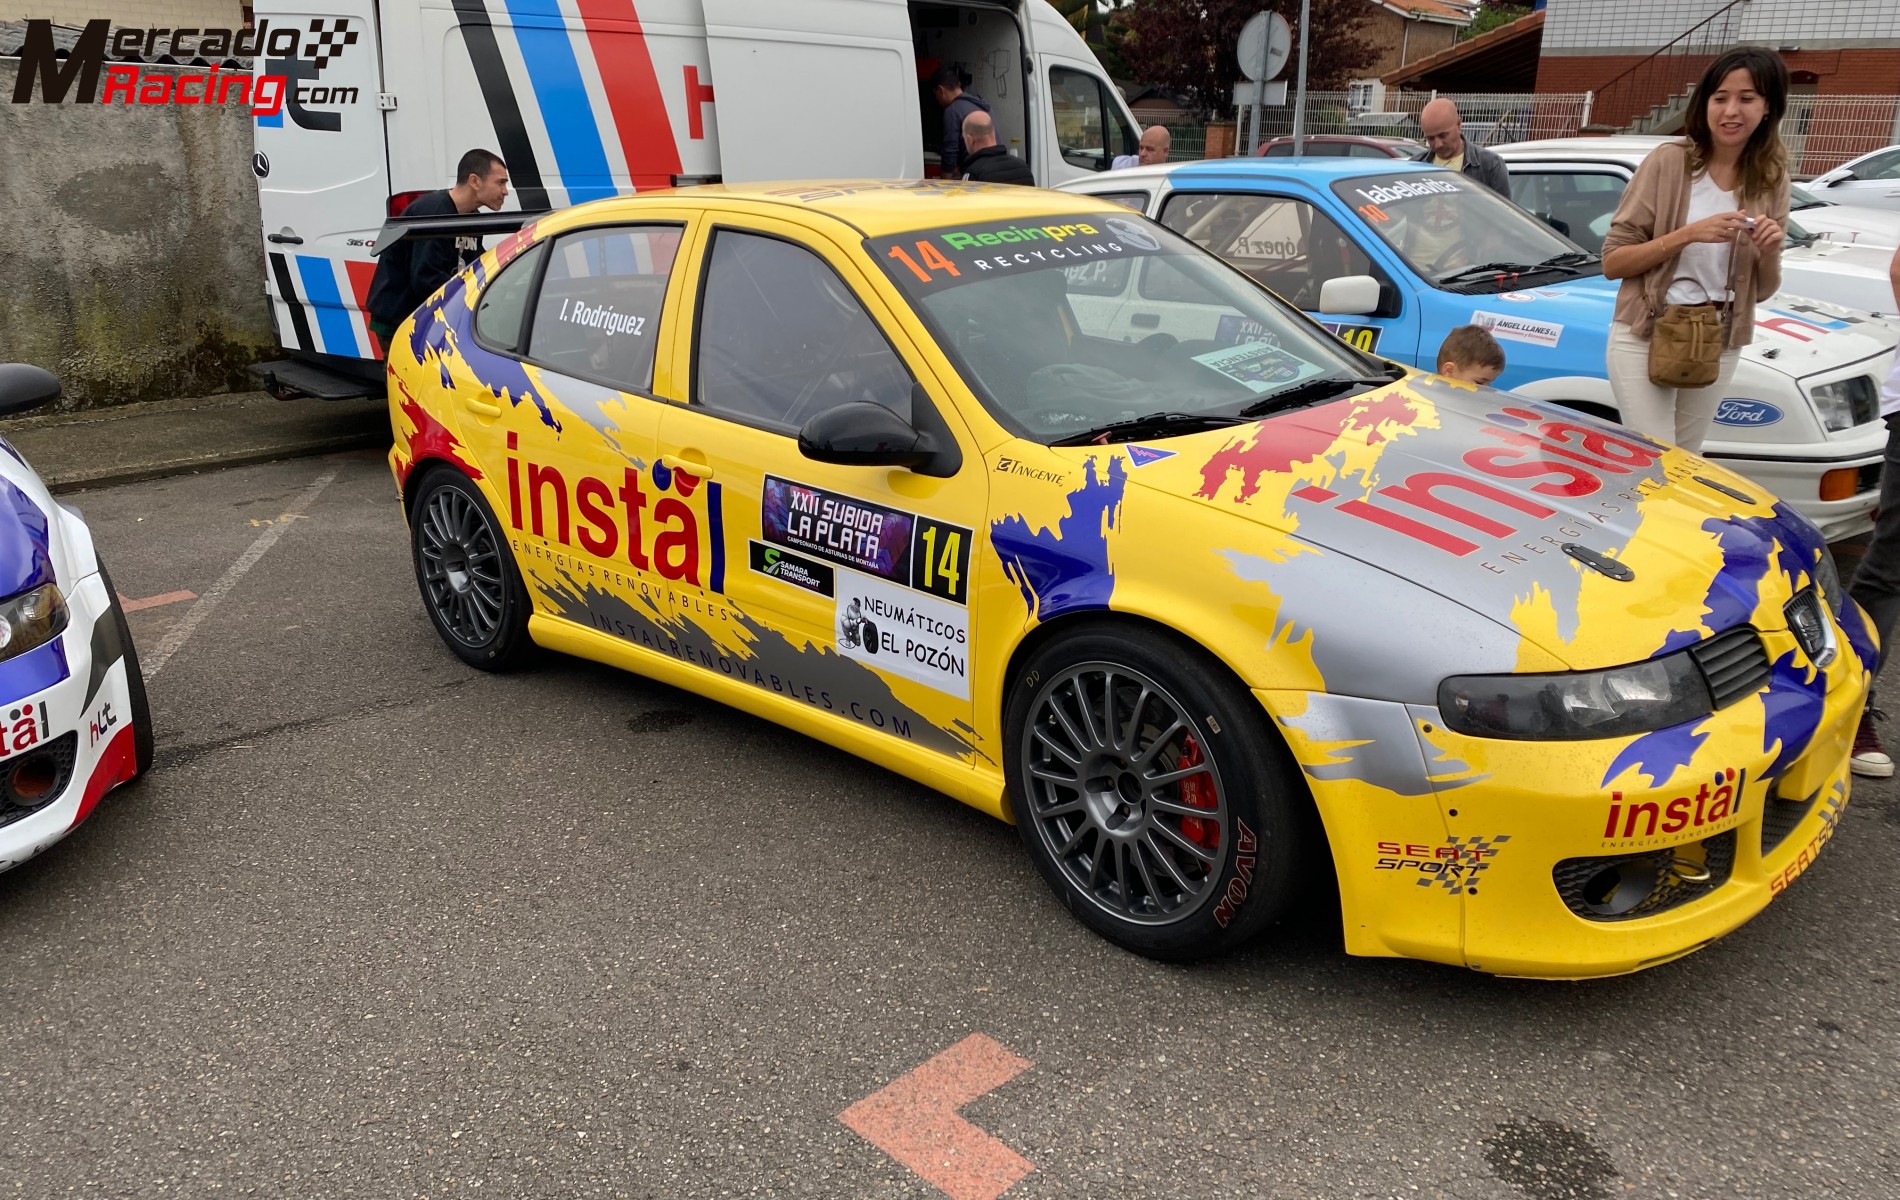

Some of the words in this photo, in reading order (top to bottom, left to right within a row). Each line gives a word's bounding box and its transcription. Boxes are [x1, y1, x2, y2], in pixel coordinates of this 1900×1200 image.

[1358, 204, 1390, 222] 10
[941, 222, 1099, 251] Recinpra
[888, 240, 961, 283] 14
[973, 242, 1124, 271] RECYCLING
[559, 298, 569, 322] I.
[571, 300, 646, 336] Rodríguez
[1497, 319, 1521, 330] ÁNGEL
[1521, 324, 1550, 336] LLANES
[1343, 328, 1374, 353] 10
[1717, 401, 1767, 422] Ford
[822, 500, 883, 535] SUBIDA
[786, 535, 818, 550] CAMPEONATO
[825, 547, 848, 560] ASTURIAS
[787, 511, 812, 540] LA
[815, 521, 879, 560] PLATA
[780, 560, 809, 577] SAMARA
[922, 525, 961, 596] 14
[512, 539, 595, 576] ENERGÍAS
[603, 569, 728, 621] RENOVABLES
[780, 568, 821, 588] TRANSPORT
[864, 595, 967, 644] NEUMÁTICOS
[881, 631, 900, 654] EL
[906, 645, 965, 678] POZÓN
[1377, 841, 1490, 862] SEAT
[1213, 816, 1257, 928] AVON
[1374, 858, 1489, 878] SPORT
